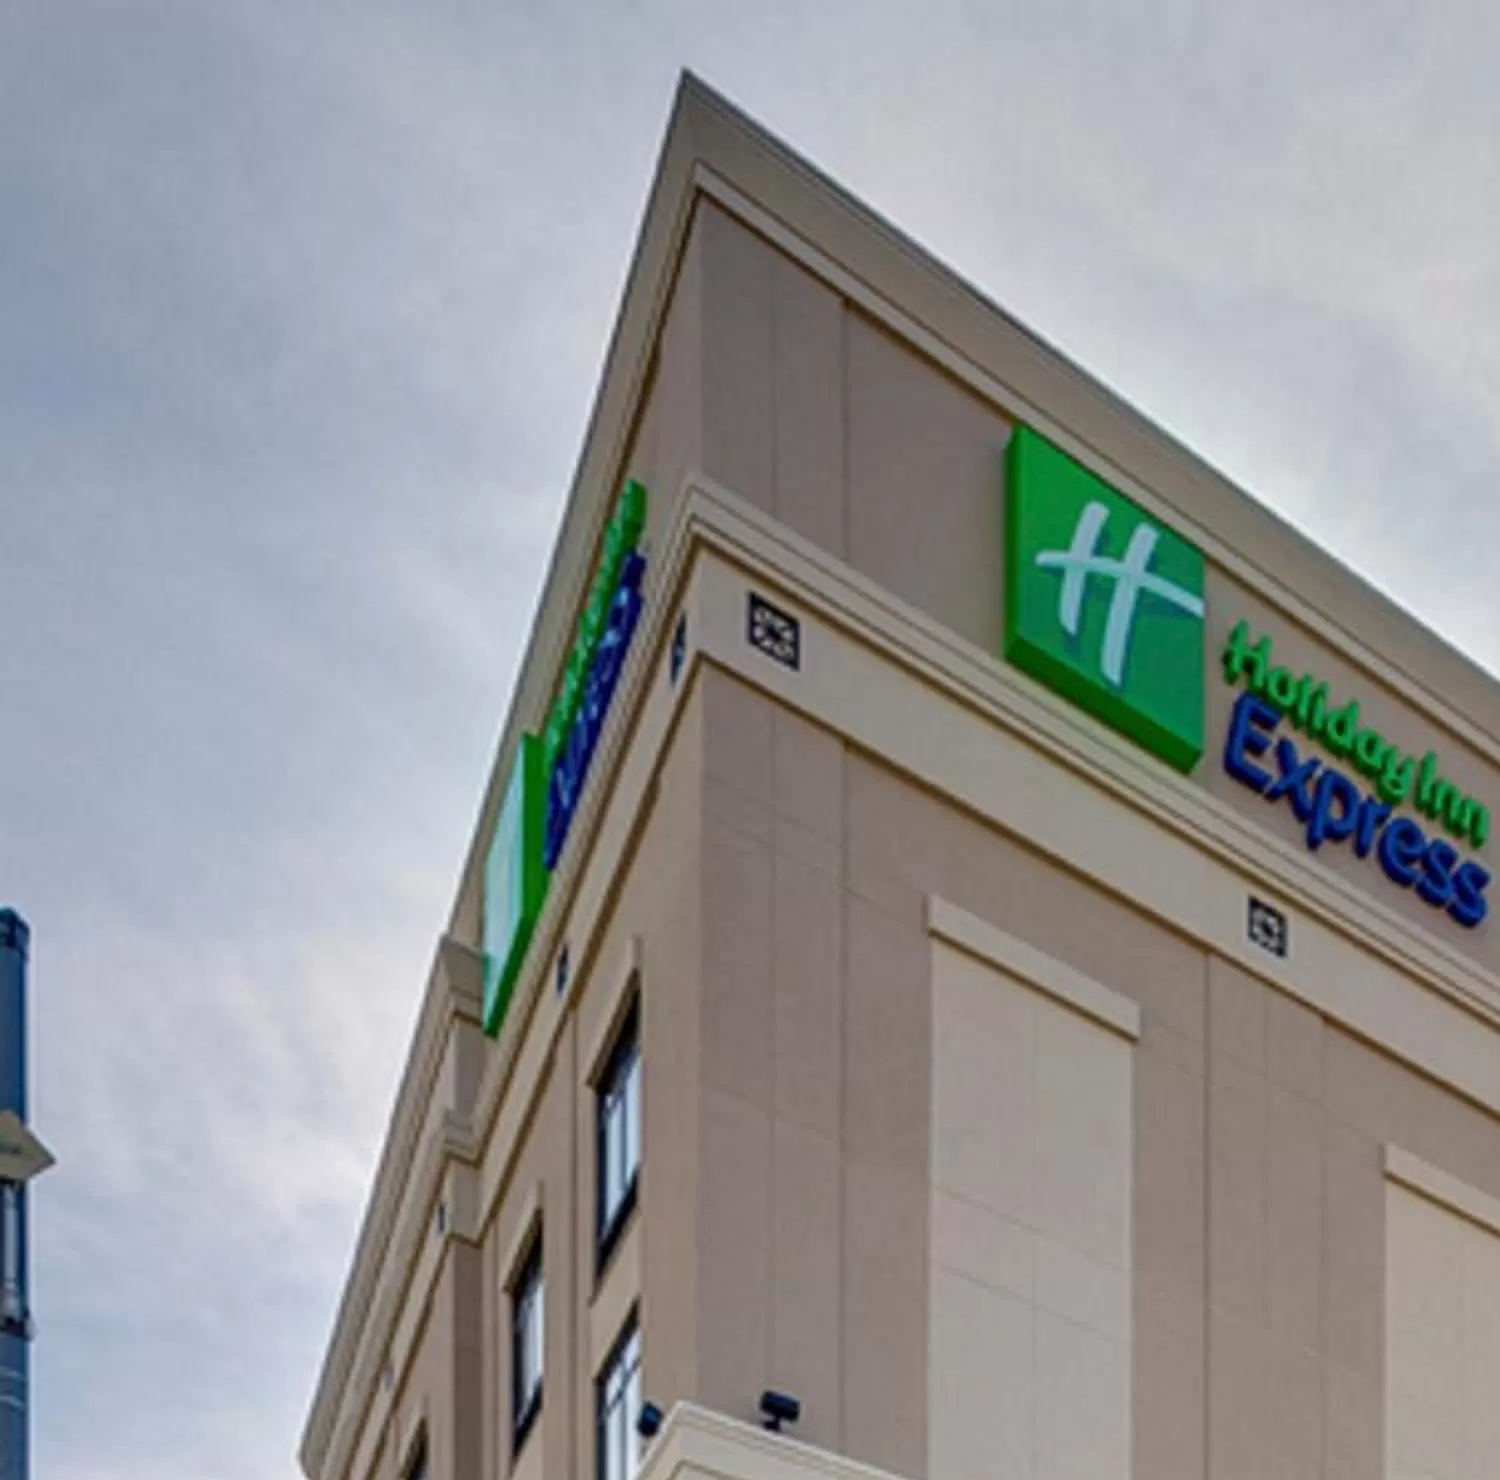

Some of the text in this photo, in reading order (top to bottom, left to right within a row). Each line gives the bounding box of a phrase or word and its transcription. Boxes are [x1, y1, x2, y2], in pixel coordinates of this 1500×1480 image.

[1223, 620, 1491, 847] Holiday Inn
[1224, 692, 1491, 928] Express
